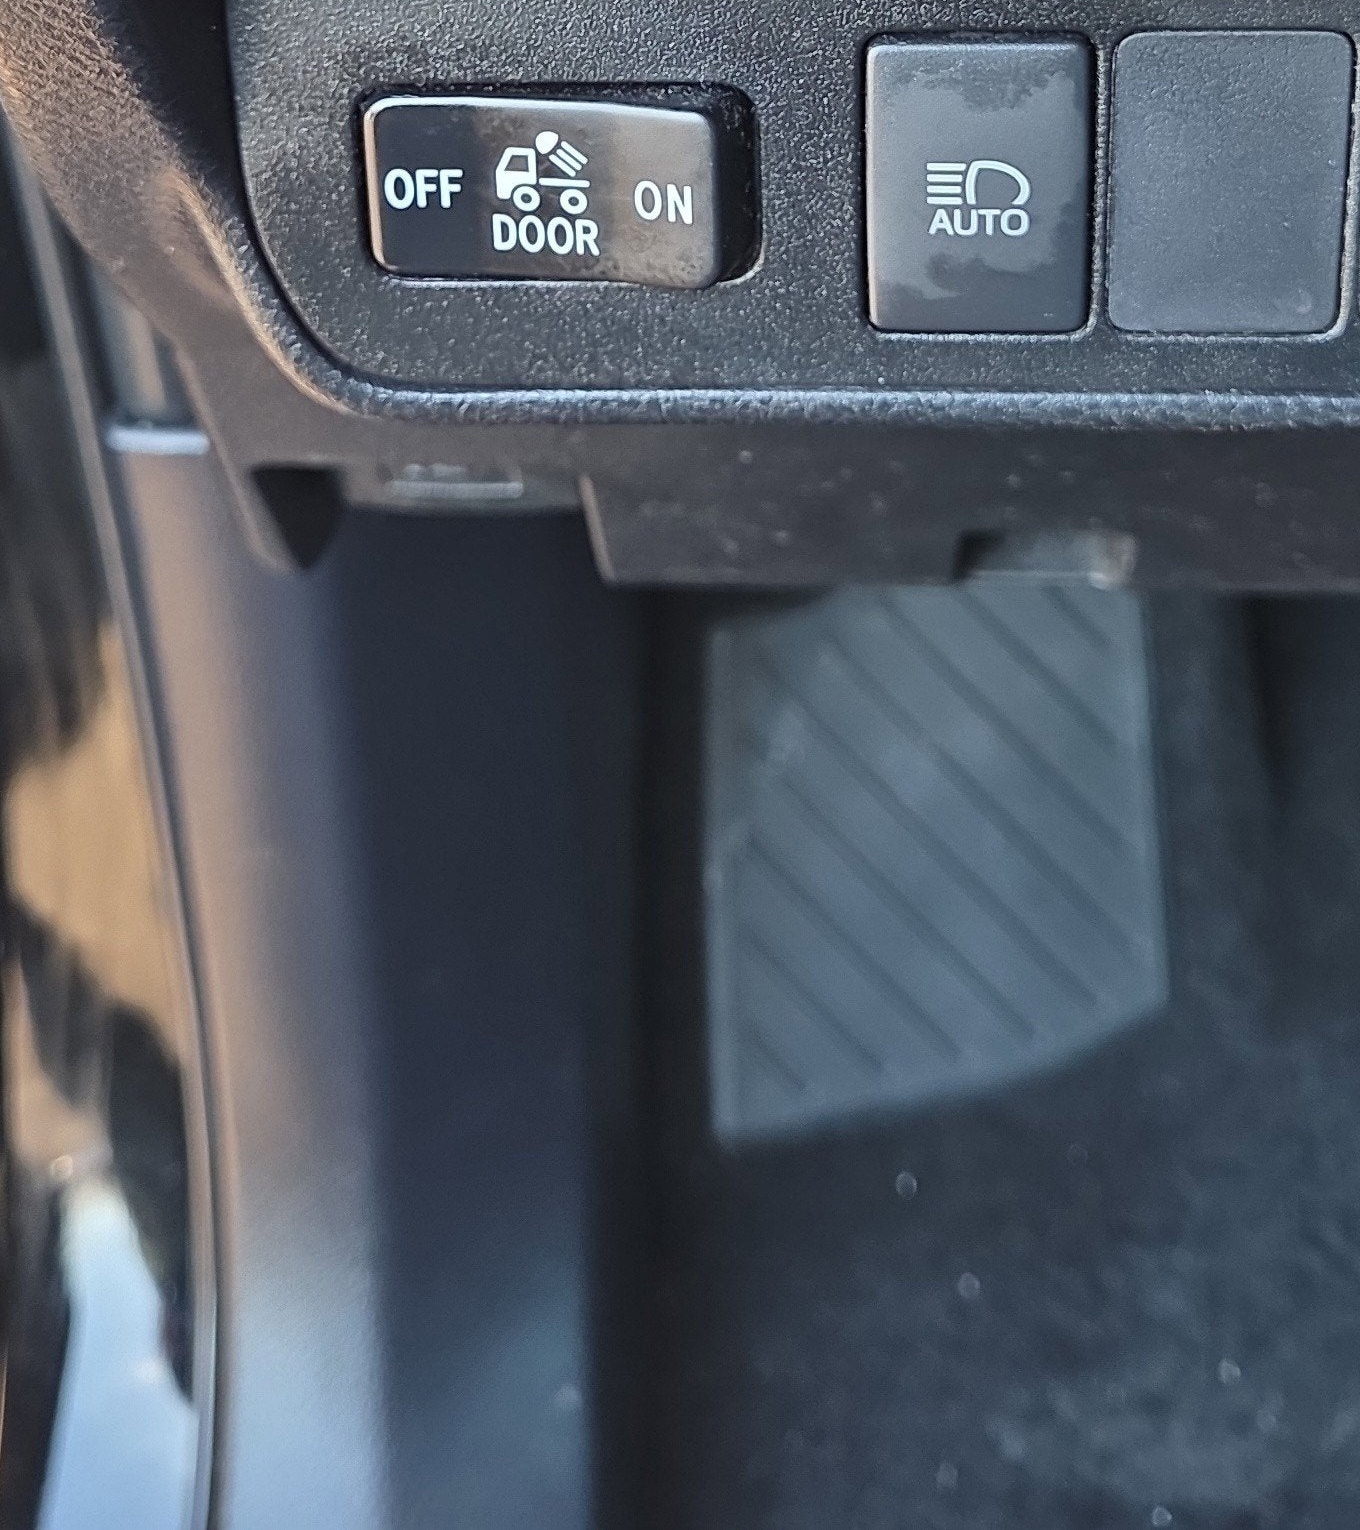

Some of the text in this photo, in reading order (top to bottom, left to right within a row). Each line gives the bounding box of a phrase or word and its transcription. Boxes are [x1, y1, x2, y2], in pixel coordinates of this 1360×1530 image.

[384, 168, 463, 210] OFF
[634, 180, 694, 225] ON
[492, 213, 600, 256] DOOR
[928, 208, 1030, 237] AUTO
